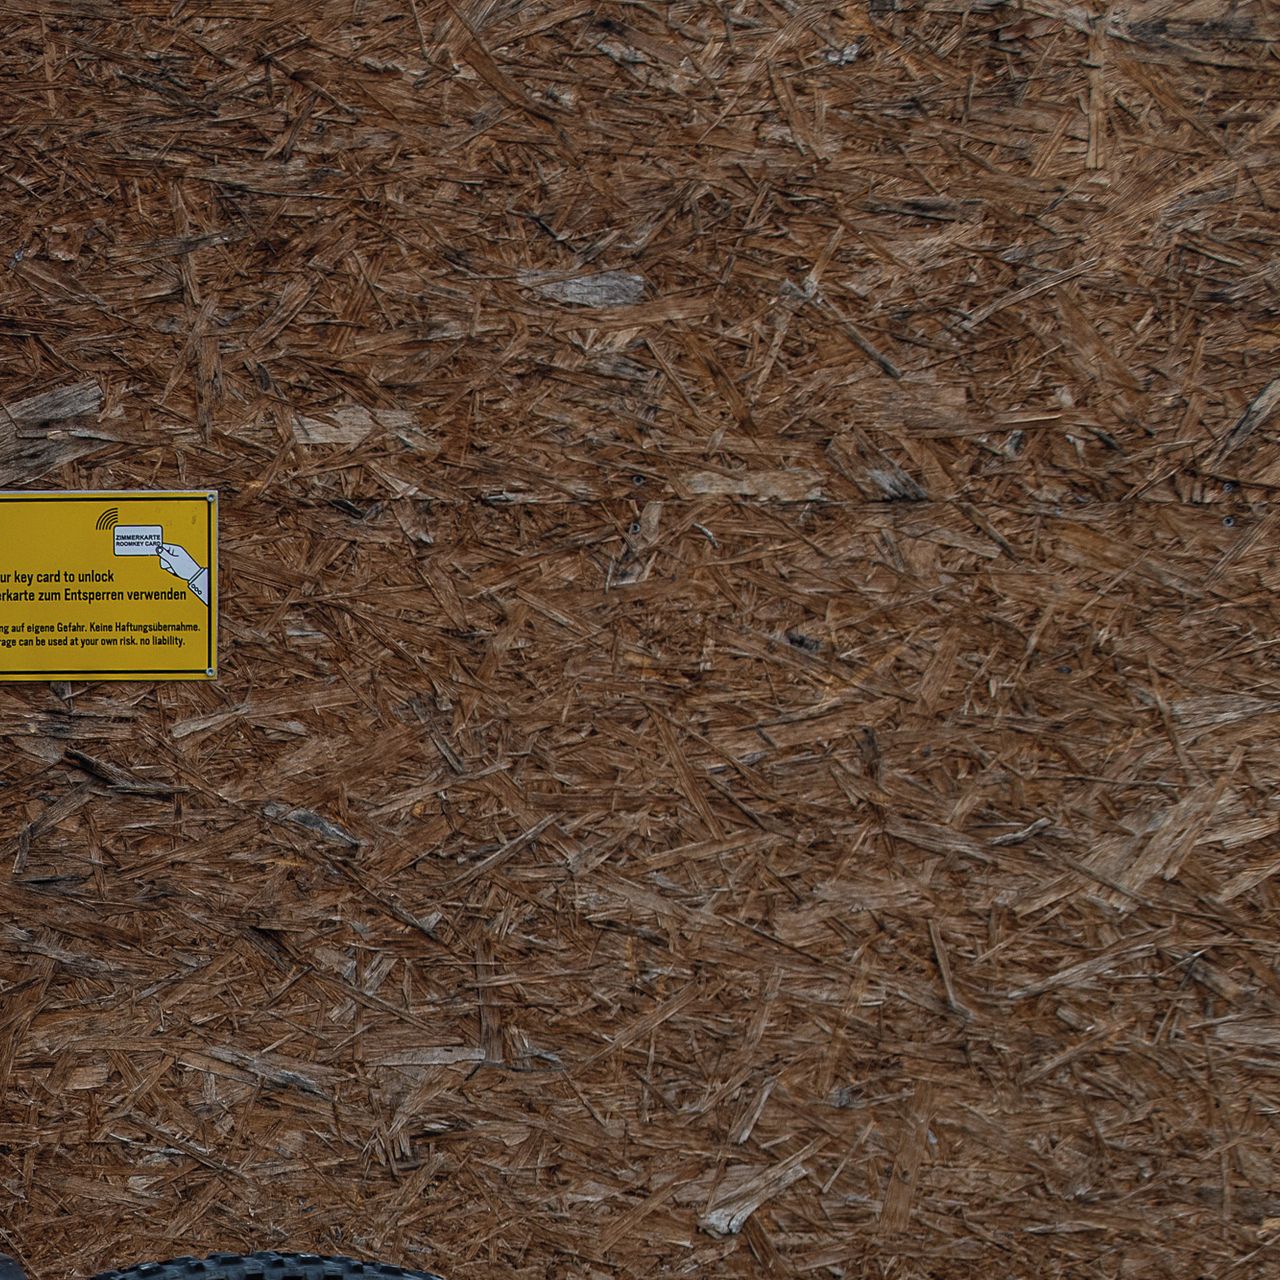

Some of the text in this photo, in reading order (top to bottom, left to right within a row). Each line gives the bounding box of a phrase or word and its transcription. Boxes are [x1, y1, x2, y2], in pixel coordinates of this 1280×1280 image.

[14, 570, 34, 587] key
[36, 570, 61, 583] card
[63, 571, 75, 583] to
[78, 569, 115, 583] unlock
[38, 591, 61, 601] zum
[64, 587, 124, 605] Entsperren
[127, 587, 187, 601] verwenden
[11, 622, 25, 633] auf
[27, 623, 55, 635] eigene
[57, 622, 88, 633] Gefahr.
[89, 622, 113, 632] Keine
[115, 621, 201, 634] Haftungsübernahme.
[18, 639, 34, 647] can
[35, 636, 46, 647] be
[47, 636, 68, 647] used
[69, 637, 79, 647] at
[80, 637, 98, 649] your
[100, 638, 118, 646] own
[120, 635, 138, 646] risk.
[140, 638, 150, 646] no
[152, 635, 186, 648] liability.
